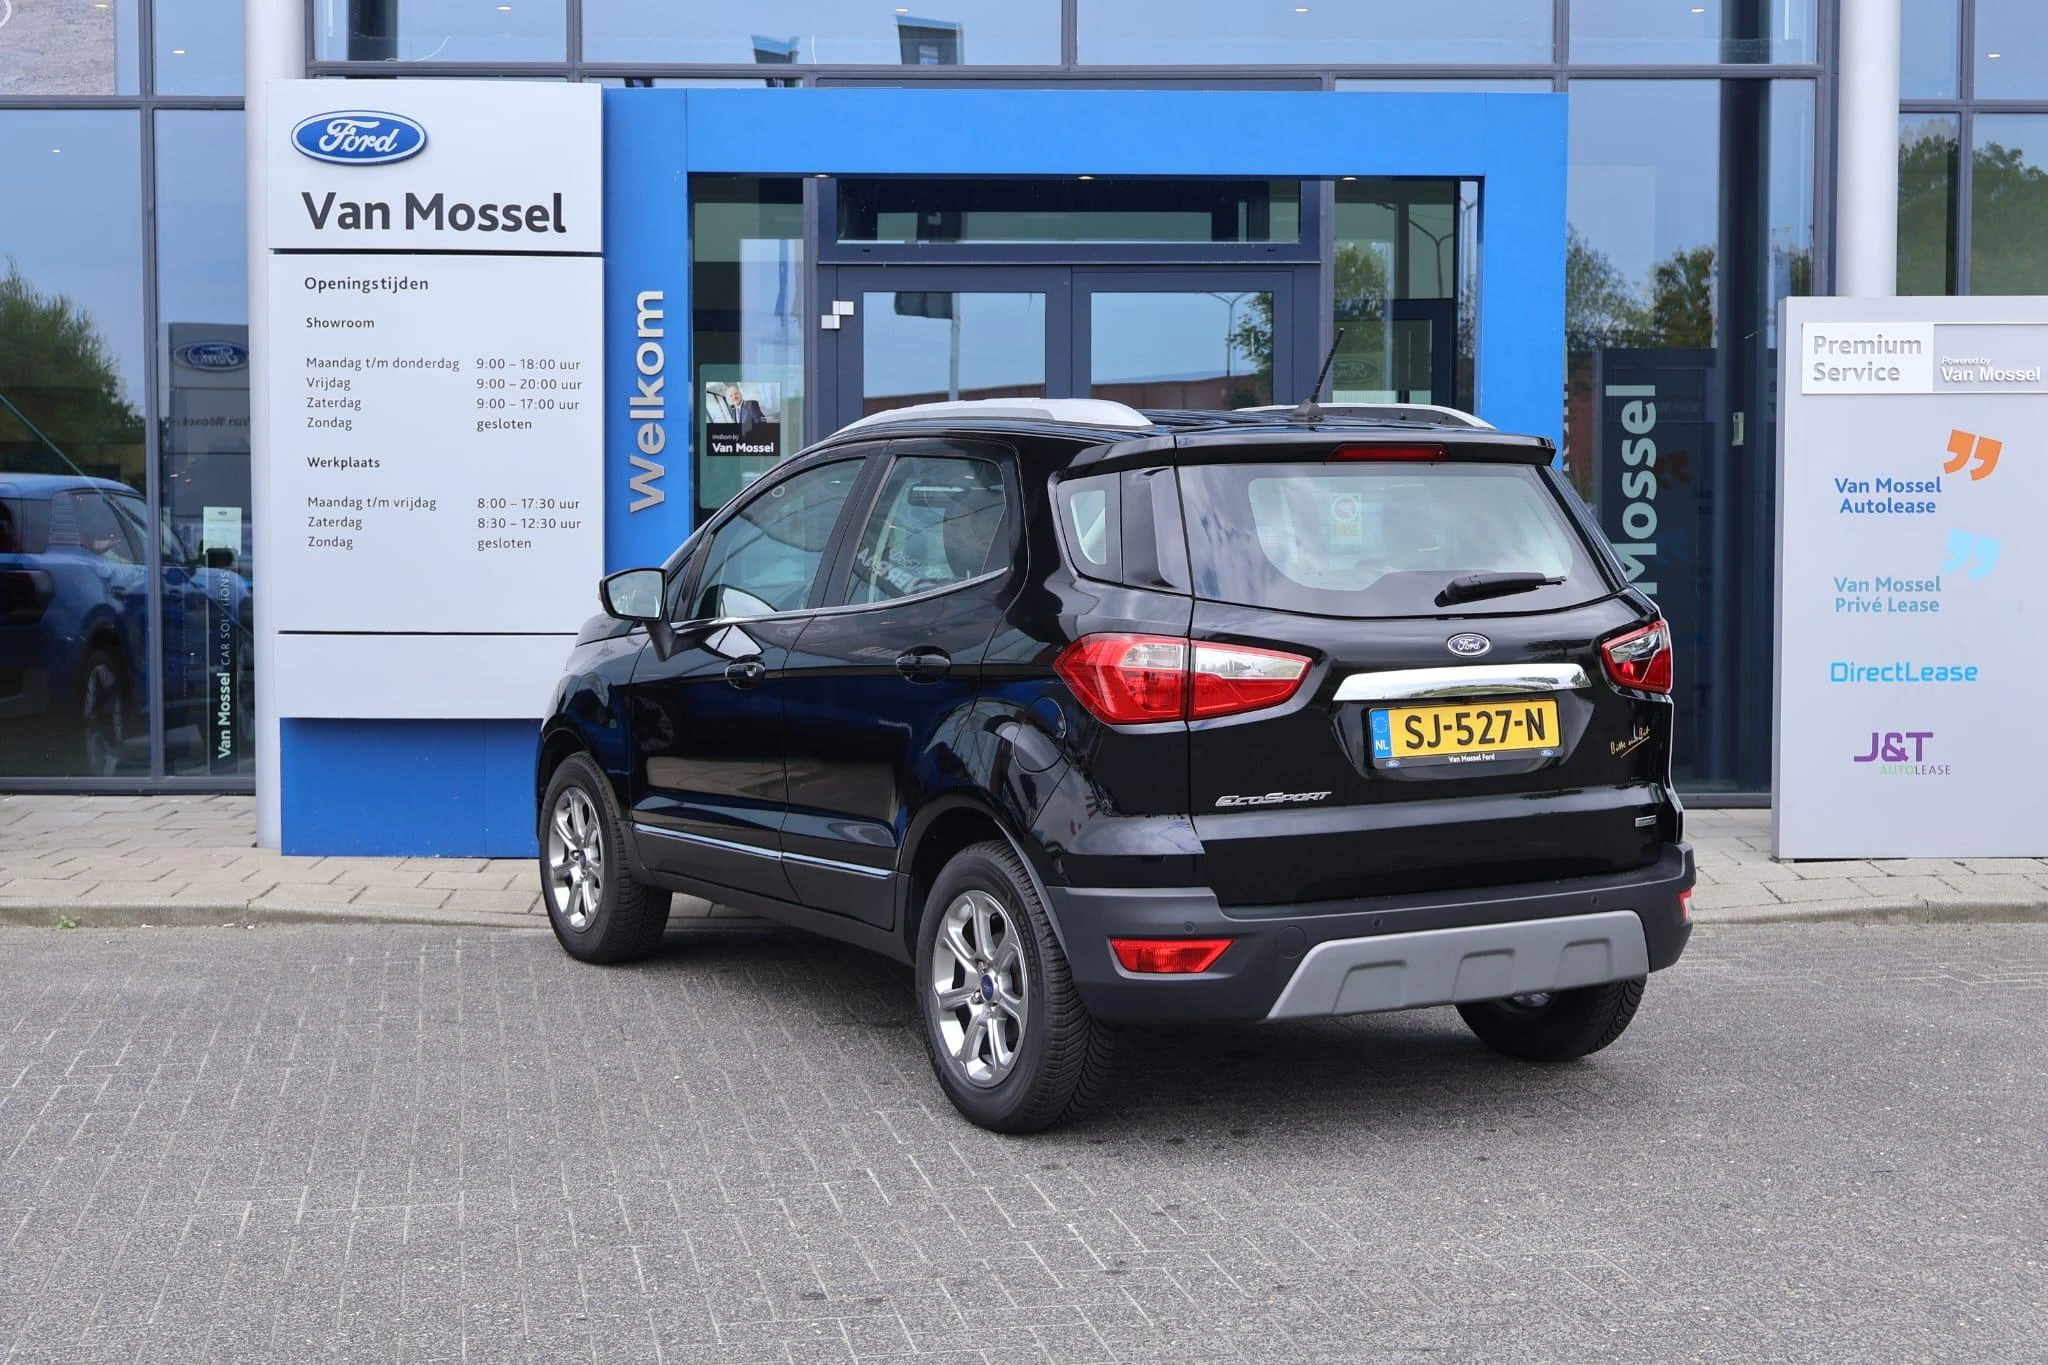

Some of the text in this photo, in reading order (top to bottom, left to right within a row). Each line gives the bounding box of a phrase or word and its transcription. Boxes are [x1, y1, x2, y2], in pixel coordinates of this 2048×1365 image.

[318, 118, 400, 153] Ford
[301, 191, 567, 234] Van Mossel
[304, 276, 429, 294] Openingstijden
[306, 317, 375, 329] Showroom
[1813, 334, 1922, 355] Premium
[306, 357, 460, 372] Maandag t/m donderdag
[476, 358, 505, 369] 9:00
[519, 358, 556, 370] 18:00
[560, 361, 581, 370] uur
[1942, 356, 1992, 366] Powered by
[1813, 361, 1901, 382] Service
[1940, 366, 2041, 382] Van Mossel
[306, 376, 351, 391] Vrijdag
[476, 378, 505, 389] 9:00
[519, 378, 558, 390] 20:00
[561, 381, 582, 390] uur
[306, 397, 362, 411] Zaterdag
[476, 398, 505, 409] 9:00
[519, 398, 555, 410] 17:00
[559, 401, 580, 410] uur
[629, 290, 666, 513] Welkom
[306, 417, 353, 431] Zondag
[476, 418, 533, 432] gesloten
[712, 442, 774, 453] Van Mossel
[307, 457, 381, 471] Werkplaats
[1606, 384, 1657, 595] Mossel
[1834, 476, 1942, 493] Van Mossel
[307, 496, 437, 511] Maandag t/m vrijdag
[477, 498, 506, 509] 8:00
[521, 498, 555, 509] 17:30
[559, 500, 580, 509] uur
[1839, 497, 1937, 514] Autolease
[307, 516, 363, 531] Zaterdag
[477, 518, 506, 529] 8:30
[521, 518, 556, 529] 12:30
[560, 520, 581, 529] uur
[307, 536, 353, 550] Zondag
[477, 537, 532, 551] gesloten
[1833, 576, 1942, 592] Van Mossel
[1835, 597, 1940, 613] Privé Lease
[220, 643, 230, 666] CAR
[1830, 661, 1978, 683] DirectLease
[217, 672, 231, 727] Mossel
[1404, 707, 1546, 750] SJ-527-N
[218, 730, 231, 760] Van
[1375, 739, 1390, 750] NL
[1853, 732, 1934, 762] J&T
[1448, 753, 1496, 763] Van Mossel Ford
[1879, 765, 1951, 776] AUTOLEASE
